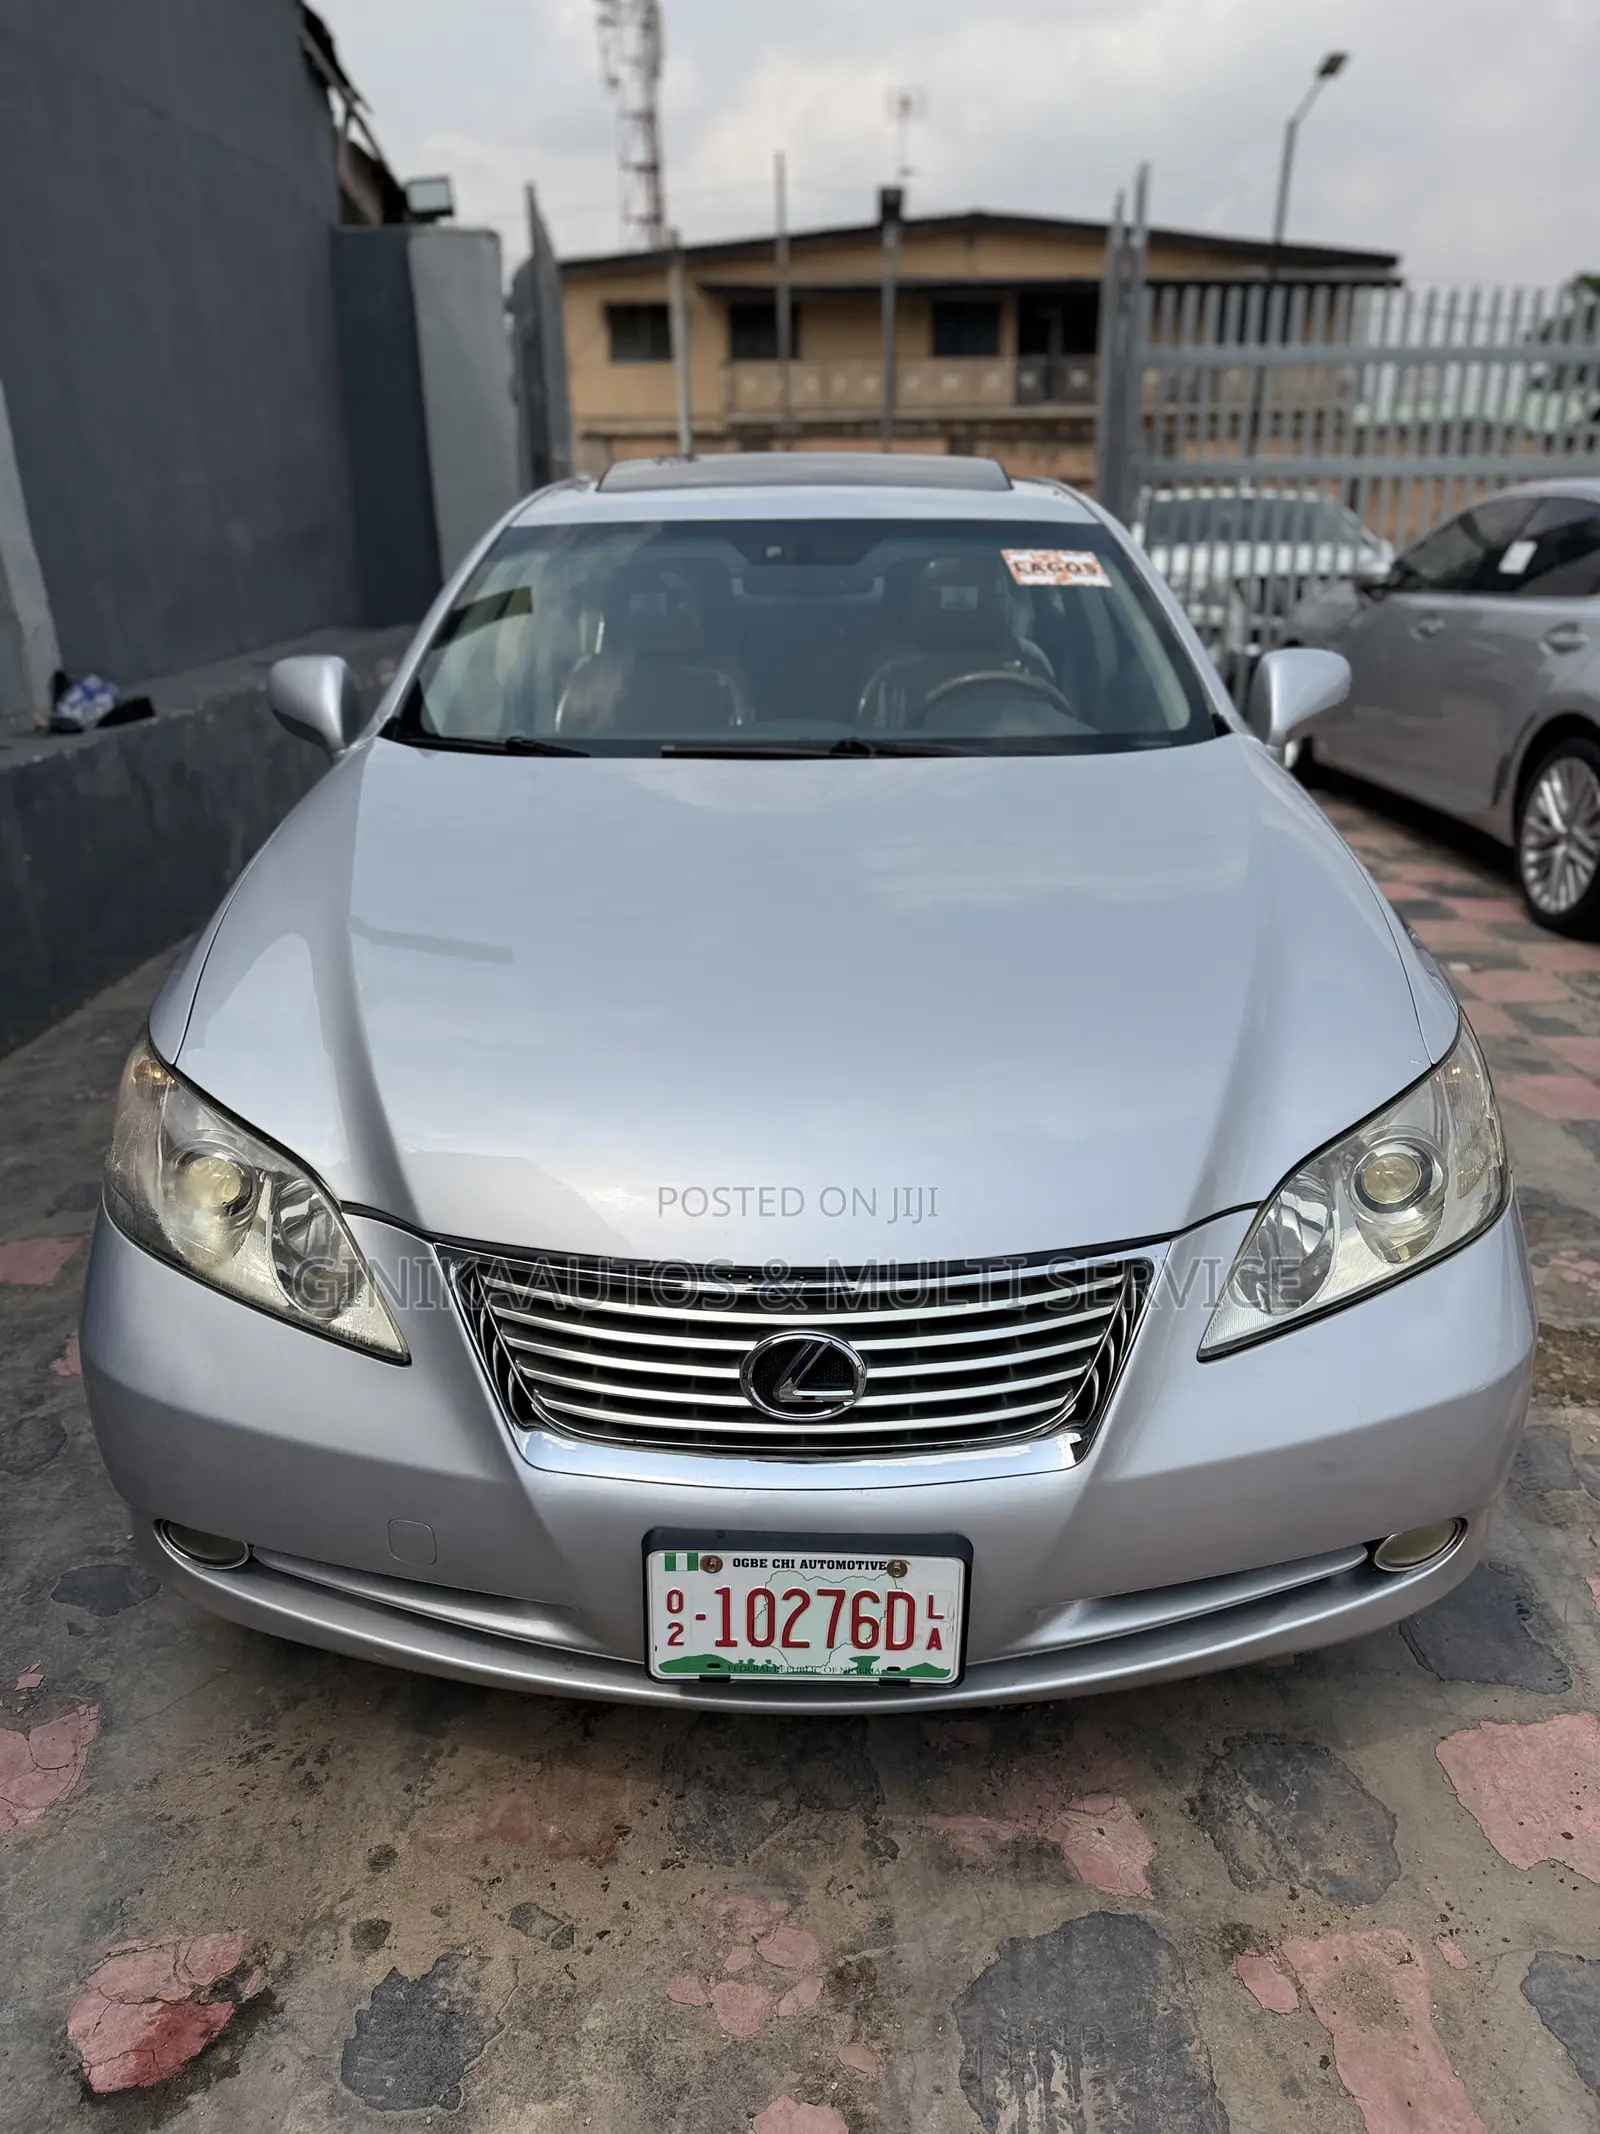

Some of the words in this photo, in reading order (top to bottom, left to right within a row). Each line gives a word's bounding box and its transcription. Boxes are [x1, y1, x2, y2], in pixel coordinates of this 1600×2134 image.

[732, 1558, 768, 1568] OGBE
[772, 1559, 796, 1569] CHI
[799, 1559, 888, 1571] AUTOMOTIVE
[823, 1666, 838, 1675] OF
